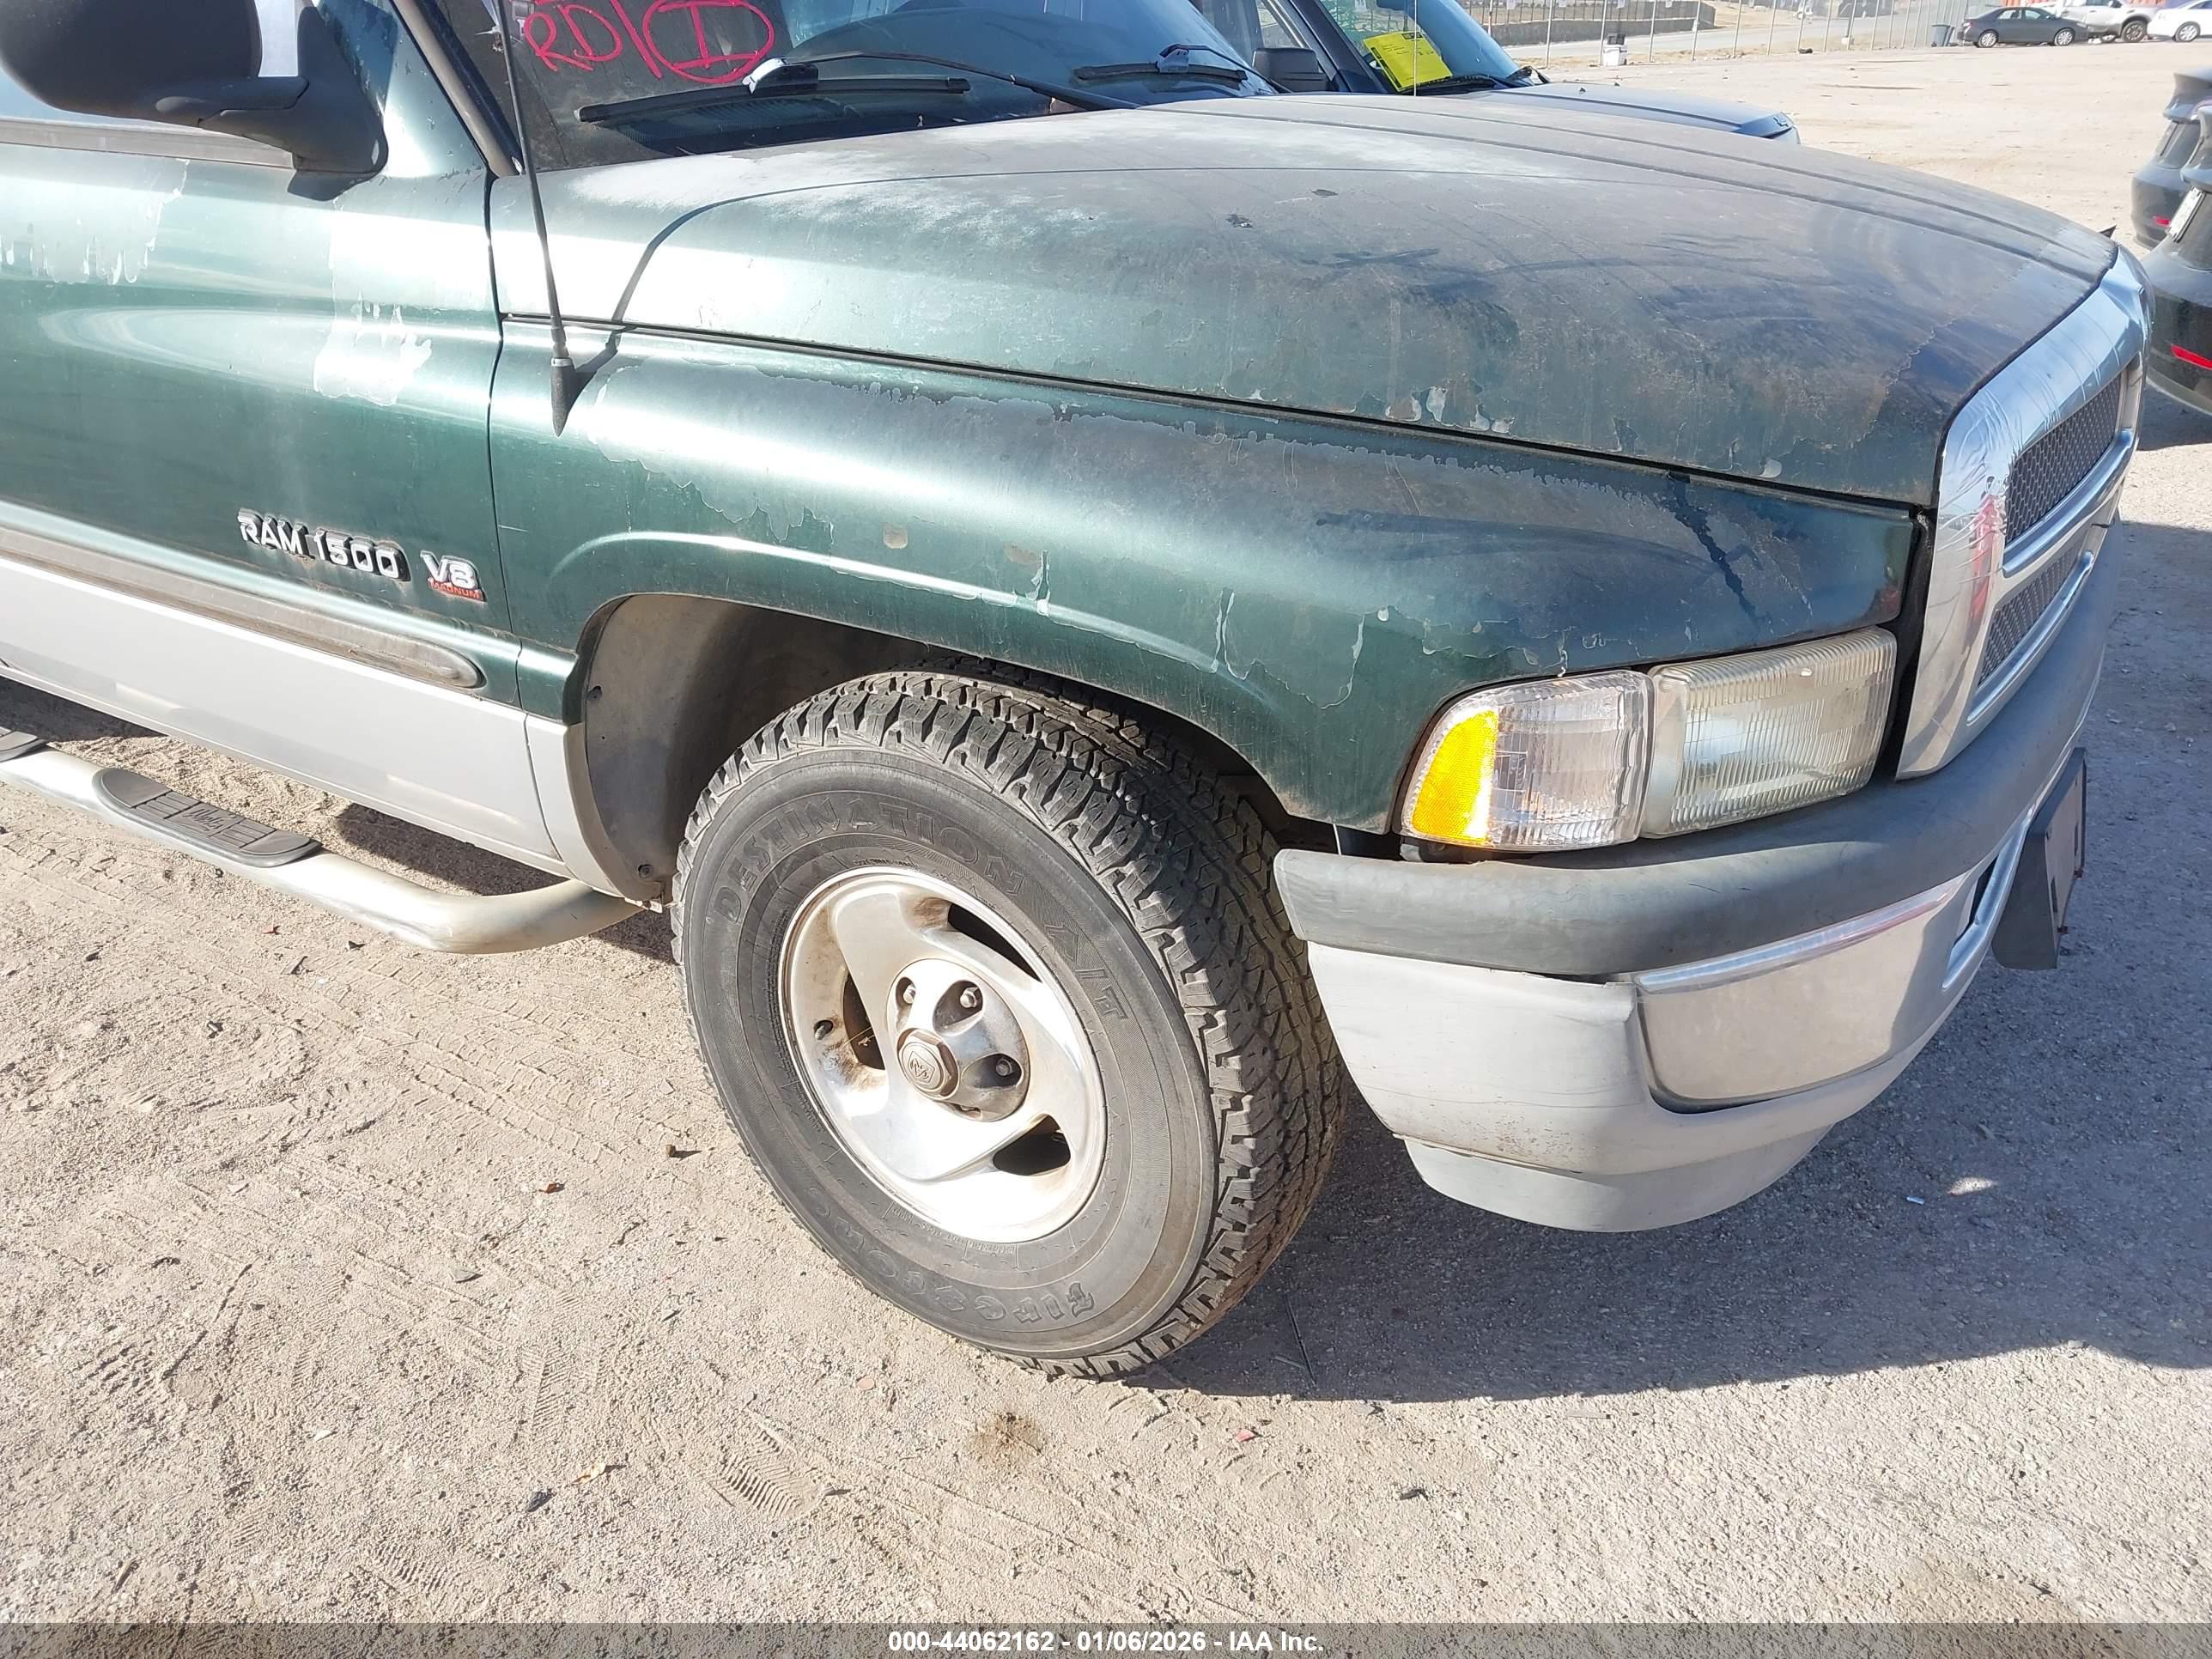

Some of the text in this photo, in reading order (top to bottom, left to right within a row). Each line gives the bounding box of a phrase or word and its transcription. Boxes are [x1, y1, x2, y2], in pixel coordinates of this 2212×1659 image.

[523, 4, 623, 71] RD
[237, 508, 411, 582] RAM 1500
[420, 550, 483, 591] V8
[714, 796, 1025, 924] DESTINATION
